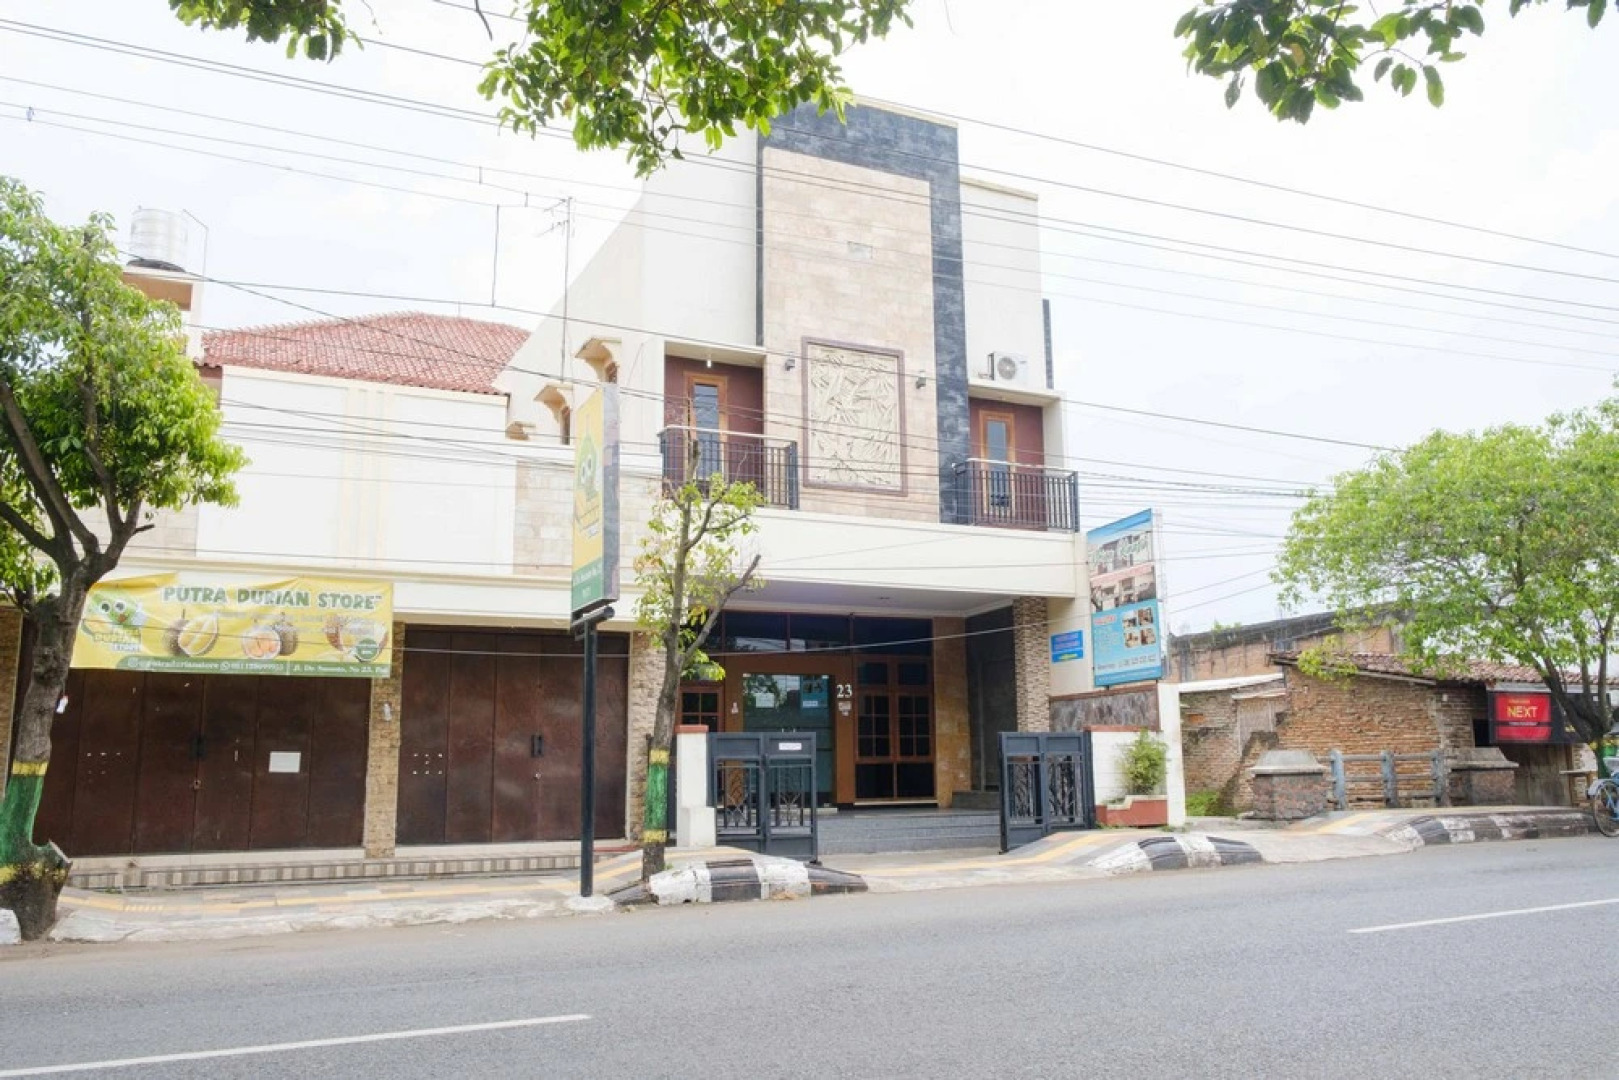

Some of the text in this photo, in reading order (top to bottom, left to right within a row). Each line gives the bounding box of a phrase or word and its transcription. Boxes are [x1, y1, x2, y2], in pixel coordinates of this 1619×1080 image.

[163, 586, 228, 603] PUTRA
[236, 588, 310, 607] DURIAN
[836, 683, 853, 699] 23
[1506, 704, 1539, 718] NEXT
